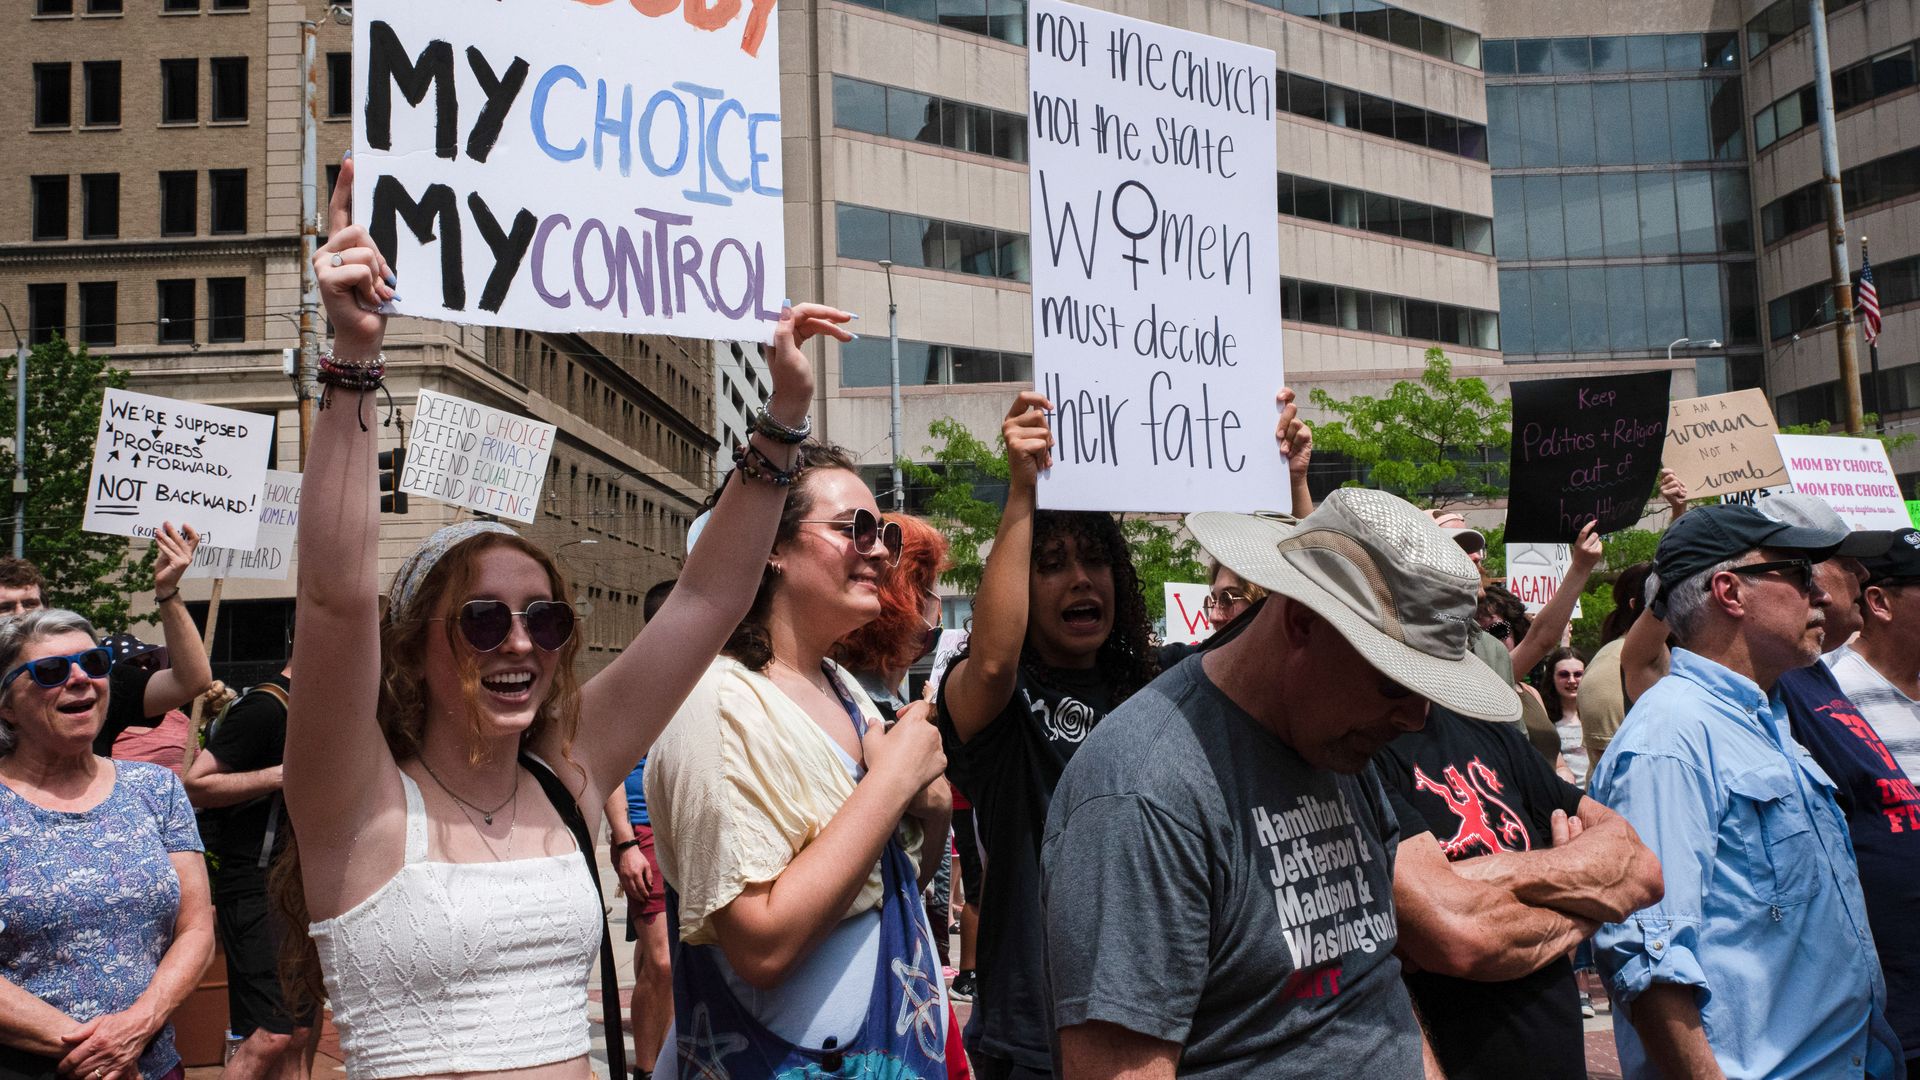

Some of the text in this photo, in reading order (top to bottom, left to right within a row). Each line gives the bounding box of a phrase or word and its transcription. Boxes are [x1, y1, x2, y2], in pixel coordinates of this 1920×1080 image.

[1037, 12, 1270, 121] not the church
[365, 20, 783, 206] MY CHOICE
[1034, 91, 1237, 179] not the state
[369, 175, 782, 322] MY CONTROL
[1041, 295, 1238, 368] must decide
[110, 399, 249, 438] WE'RE SUPPOSED
[1578, 388, 1617, 410] Keep
[1672, 400, 1728, 417] I AM A
[417, 393, 550, 451] DEFEND CHOICE
[1044, 370, 1246, 473] their fate
[1523, 422, 1595, 462] Politics
[1613, 418, 1663, 449] Religion
[1665, 412, 1769, 446] woman
[112, 429, 204, 459] PROGRESS
[412, 419, 539, 471] DEFEND PRIVACY
[1616, 453, 1633, 475] of
[1698, 442, 1739, 461] NOT A
[147, 455, 233, 479] FORWARD,
[407, 442, 543, 497] DEFEND EQUALITY
[1695, 460, 1784, 492] womb
[1790, 457, 1888, 476] MOM BY CHOICE,
[97, 473, 257, 514] NOT BACKWARD!
[262, 482, 302, 505] HOICE
[402, 466, 532, 517] DEFEND VOTING
[1796, 482, 1900, 498] MOM FOR CHOICE.
[240, 547, 282, 570] HEARD
[1511, 575, 1557, 605] AGAIN
[1251, 795, 1344, 847] Hamilton
[1269, 825, 1373, 888] Jefferson &
[1274, 875, 1357, 930] Madison
[1354, 866, 1375, 905] &
